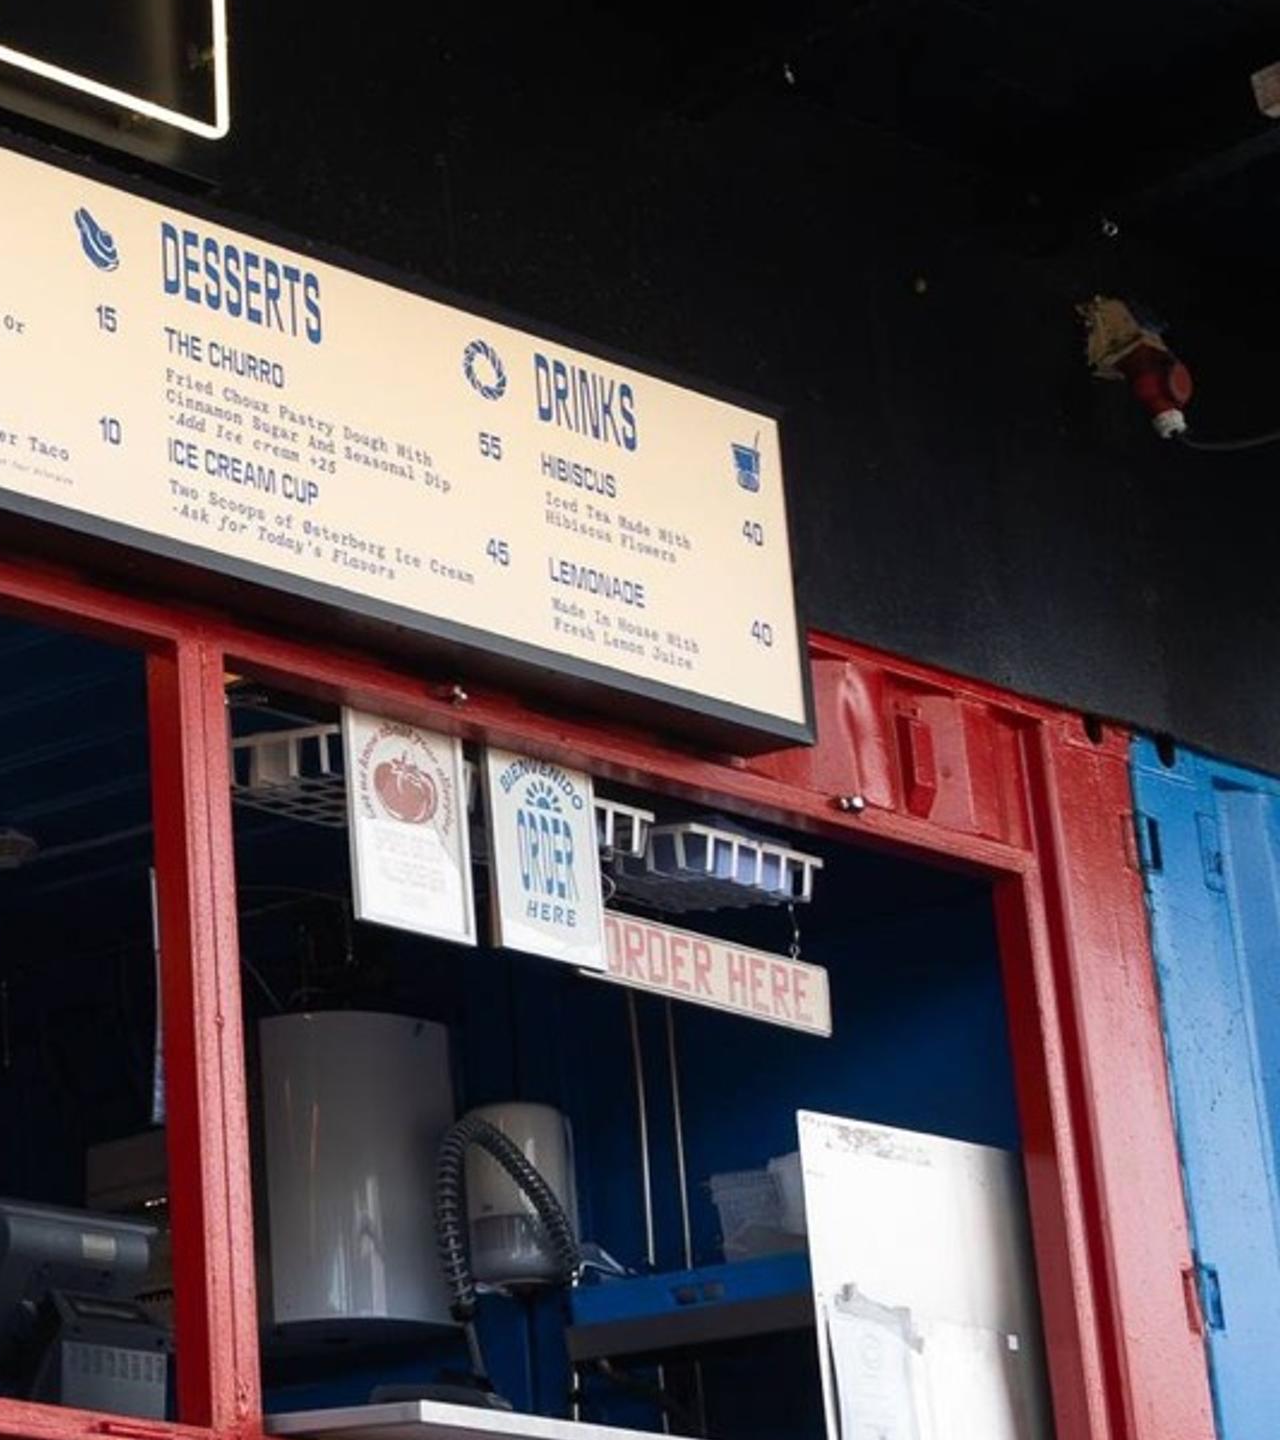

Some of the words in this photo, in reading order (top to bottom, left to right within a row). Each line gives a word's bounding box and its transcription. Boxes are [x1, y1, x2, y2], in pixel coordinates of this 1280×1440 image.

[161, 221, 322, 345] DESSERTS
[3, 314, 26, 335] Or
[95, 304, 118, 334] 15
[163, 326, 203, 363] THE
[207, 341, 285, 389] CHURRO
[533, 352, 638, 453] DRINKS
[27, 436, 70, 462] Taco
[98, 416, 122, 446] 10
[478, 431, 502, 461] 55
[168, 437, 199, 471] ICE
[204, 448, 276, 494] CREAM
[281, 473, 319, 506] CUP
[541, 453, 617, 499] HIBISCUS
[486, 538, 510, 567] 45
[742, 520, 764, 547] 40
[548, 557, 646, 609] LEMONADE
[751, 620, 773, 648] 40
[500, 758, 583, 810] BIENVENIDO
[516, 809, 579, 902] ORDER
[526, 899, 578, 928] HERE
[727, 950, 814, 1022] HERE
